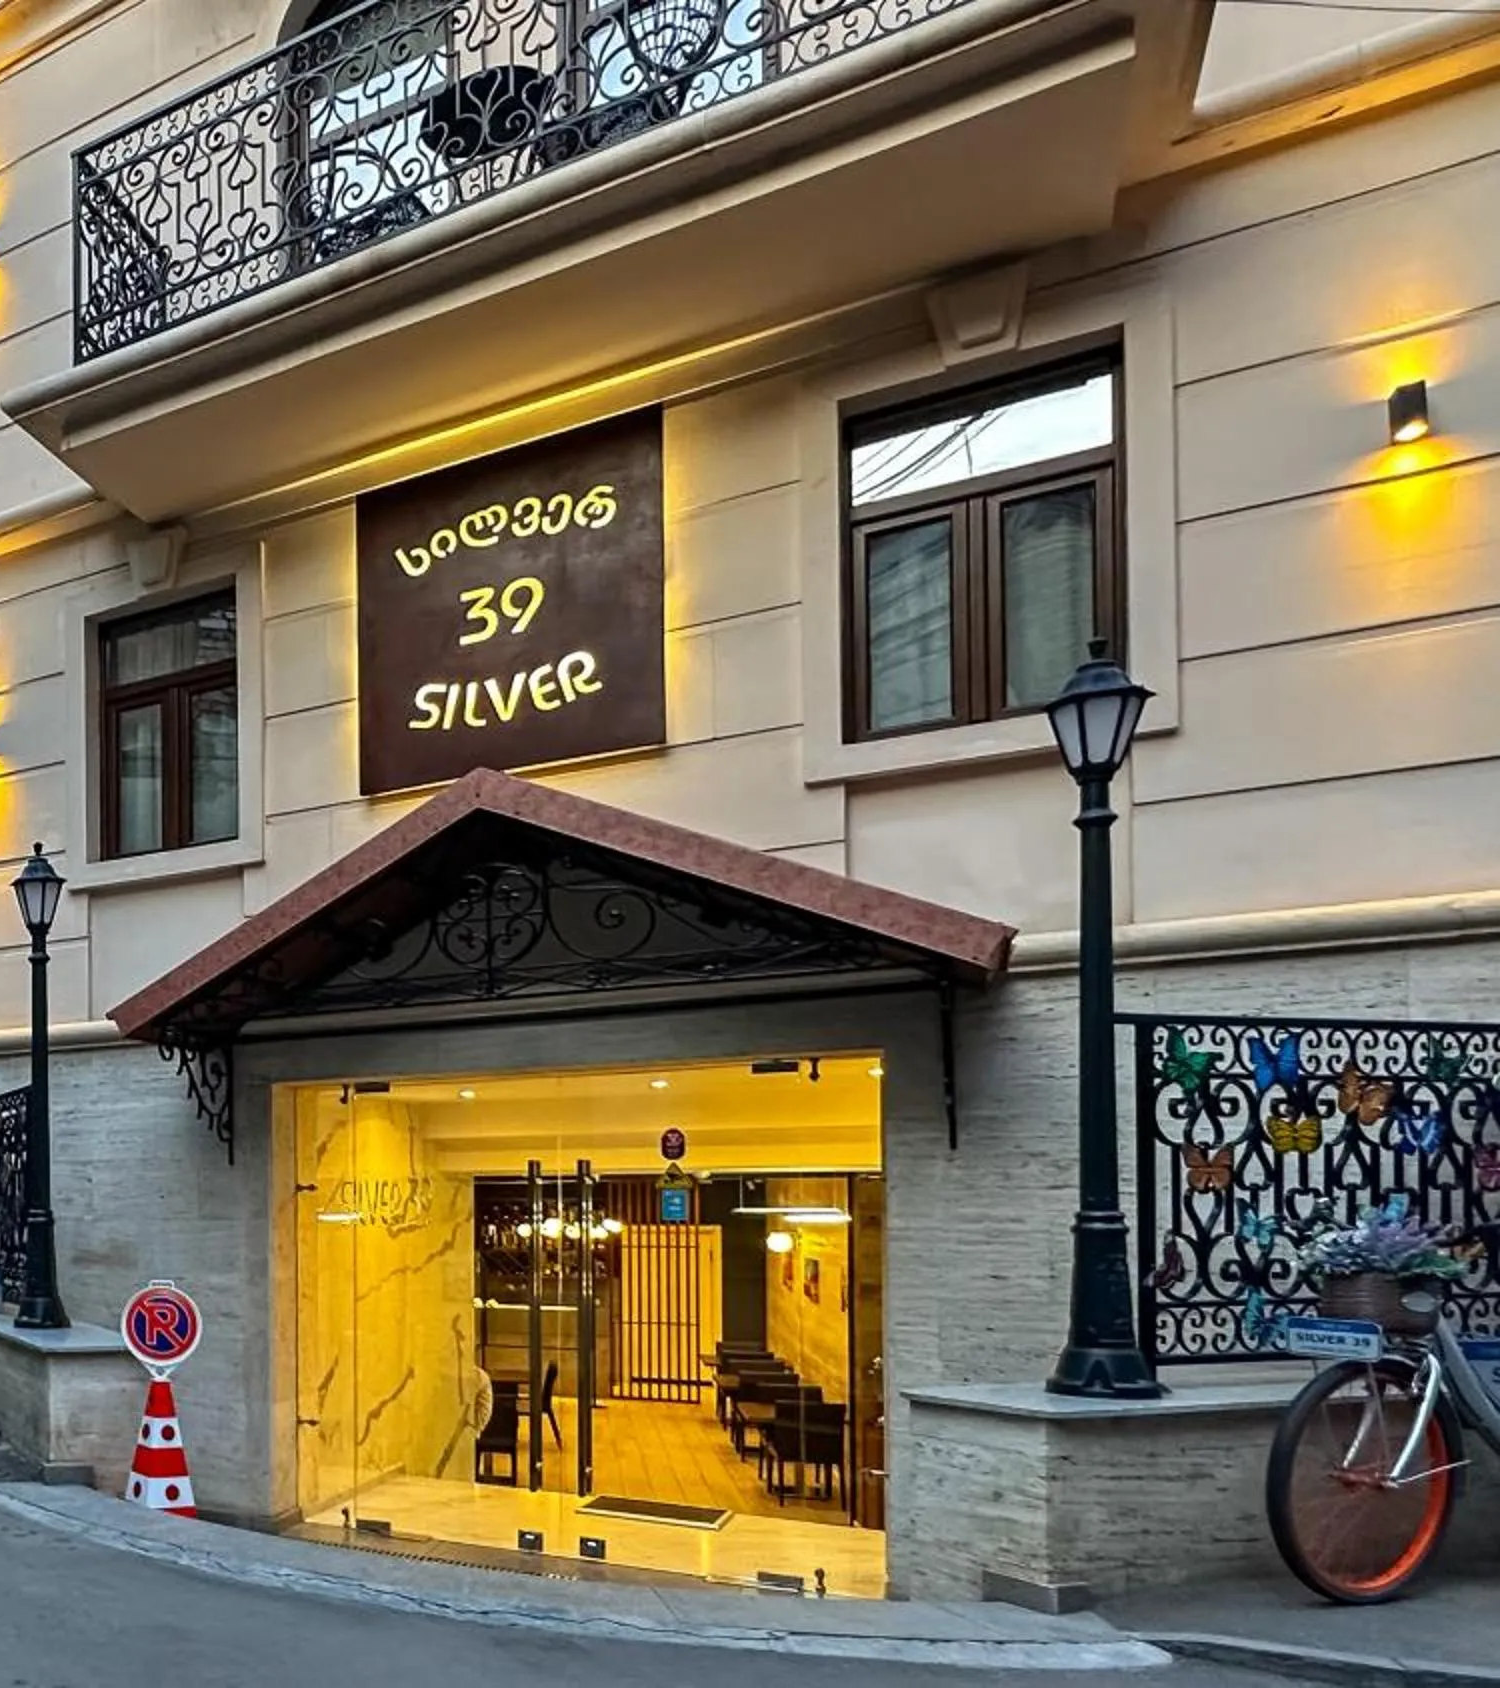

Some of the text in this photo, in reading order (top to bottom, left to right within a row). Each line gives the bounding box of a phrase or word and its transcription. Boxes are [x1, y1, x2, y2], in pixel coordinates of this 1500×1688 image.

[394, 485, 617, 577] სილვერ
[458, 576, 545, 647] 39
[408, 650, 602, 730] SILVER
[1296, 1331, 1346, 1345] SILVER
